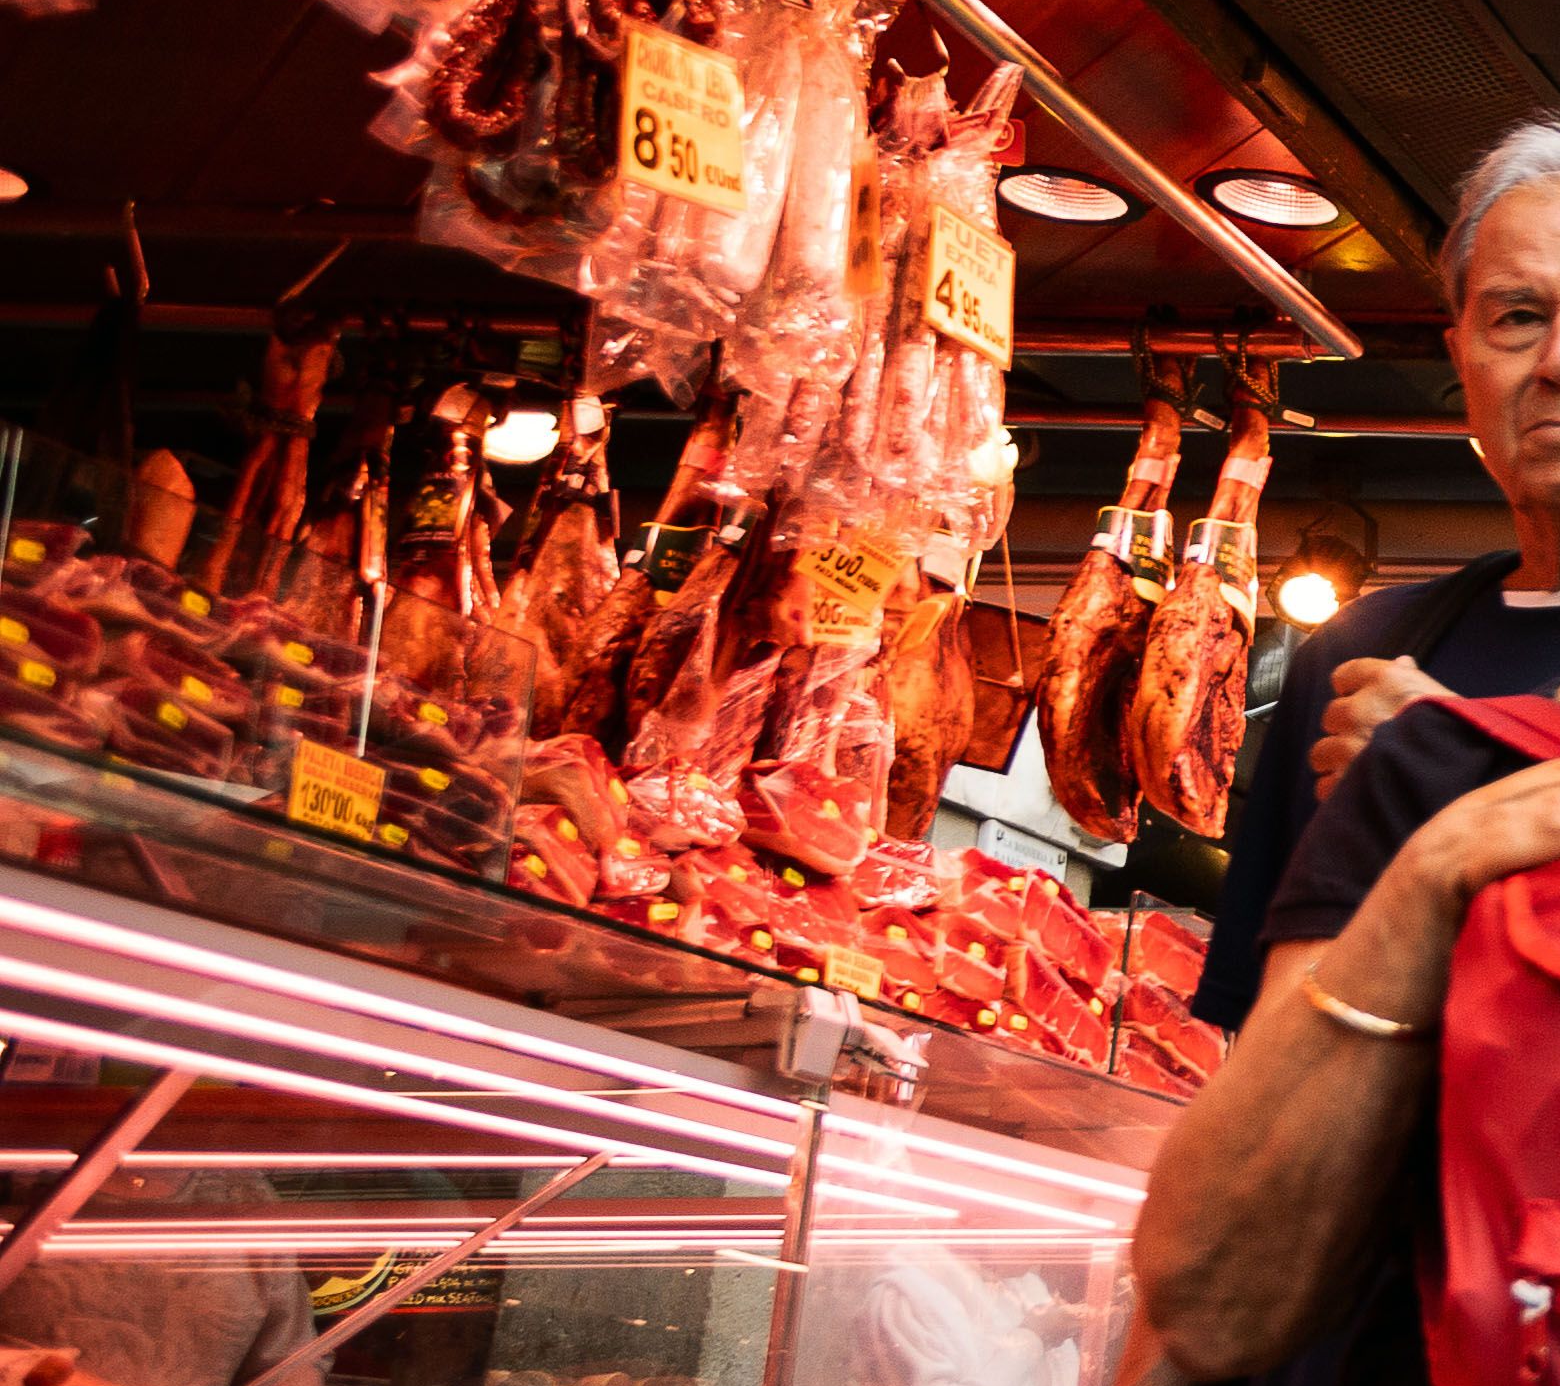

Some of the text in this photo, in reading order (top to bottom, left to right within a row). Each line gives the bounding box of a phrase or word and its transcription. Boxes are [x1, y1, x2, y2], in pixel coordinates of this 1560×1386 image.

[633, 107, 700, 185] 8'50
[938, 211, 1011, 272] FUET
[935, 268, 982, 334] 4'95
